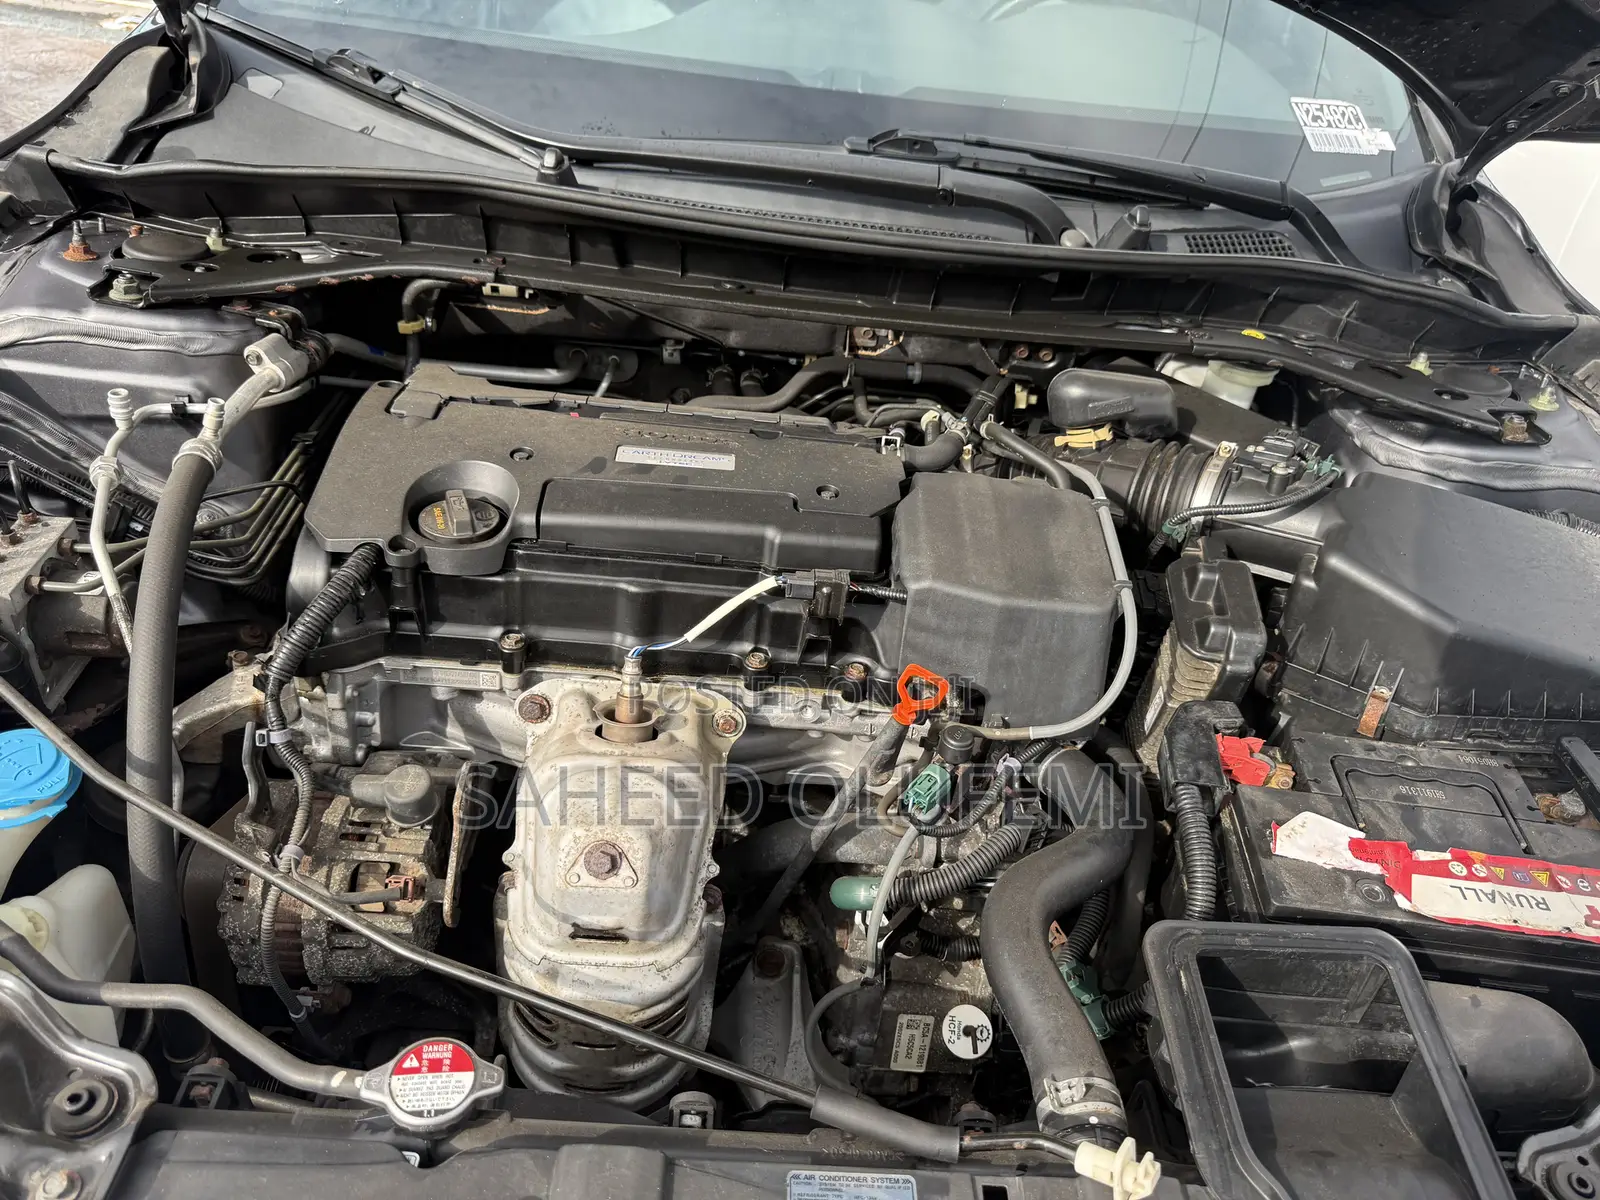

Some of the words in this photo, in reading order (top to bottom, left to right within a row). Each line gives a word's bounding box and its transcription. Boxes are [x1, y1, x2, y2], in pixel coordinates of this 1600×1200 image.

[37, 776, 65, 794] PULL
[1449, 884, 1551, 912] RUNALL
[948, 1015, 956, 1045] HCF-2
[422, 1051, 453, 1059] WARNUNG
[423, 1044, 453, 1052] DANGER
[818, 1174, 868, 1183] CONDITIONER
[871, 1176, 900, 1184] SYSTEM
